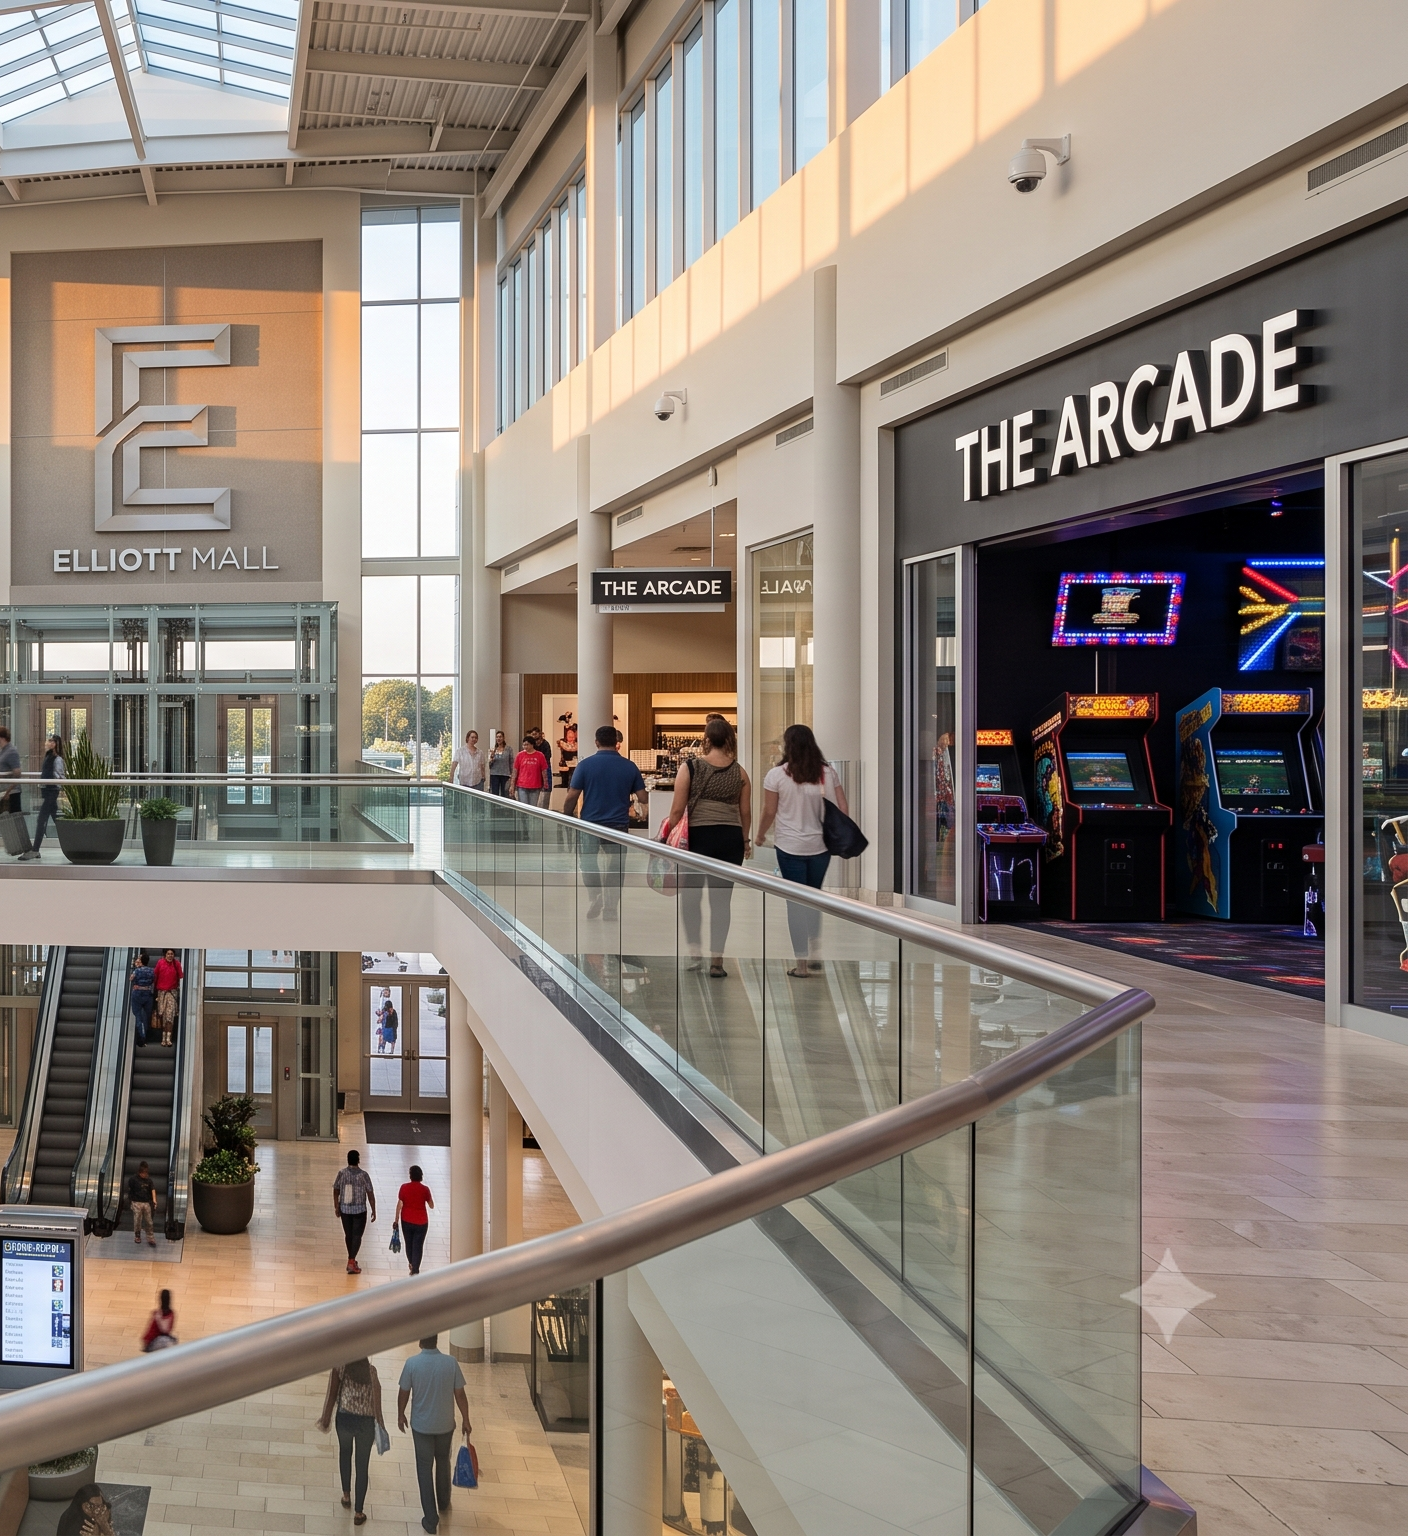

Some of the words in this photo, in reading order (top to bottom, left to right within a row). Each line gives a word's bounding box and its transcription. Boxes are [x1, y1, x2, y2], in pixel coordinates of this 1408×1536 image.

[955, 409, 1047, 502] THE
[1050, 308, 1314, 478] ARCADE
[53, 547, 182, 572] ELLIOTT
[192, 545, 280, 571] MALL
[600, 580, 638, 596] THE
[642, 579, 722, 596] ARCADE
